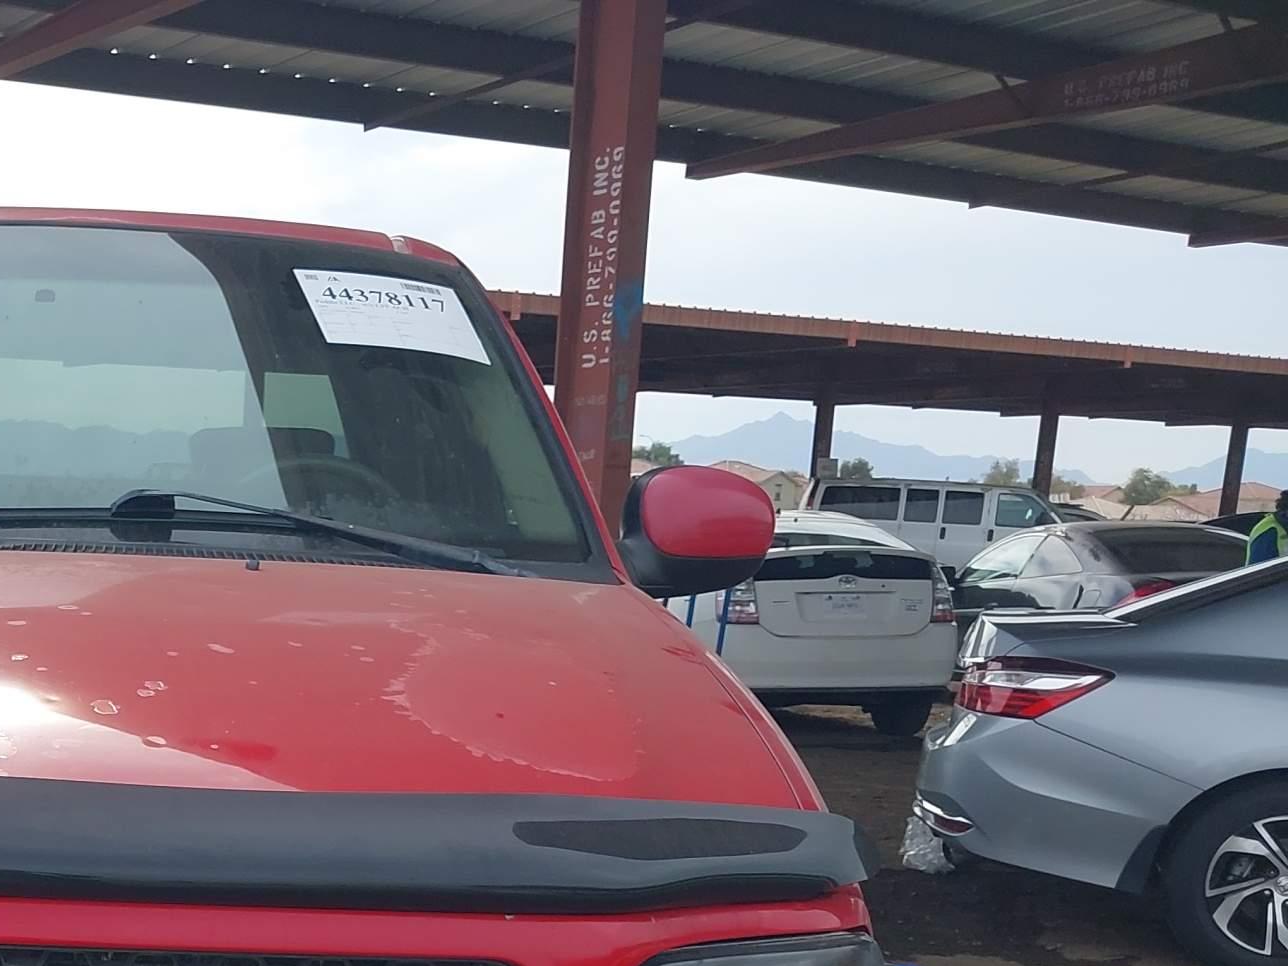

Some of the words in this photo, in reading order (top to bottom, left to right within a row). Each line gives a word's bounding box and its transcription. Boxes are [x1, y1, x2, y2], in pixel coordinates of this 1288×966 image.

[592, 147, 611, 196] INC.
[585, 208, 607, 307] PREFAB
[322, 286, 445, 313] 44378117
[581, 320, 599, 369] U.S.
